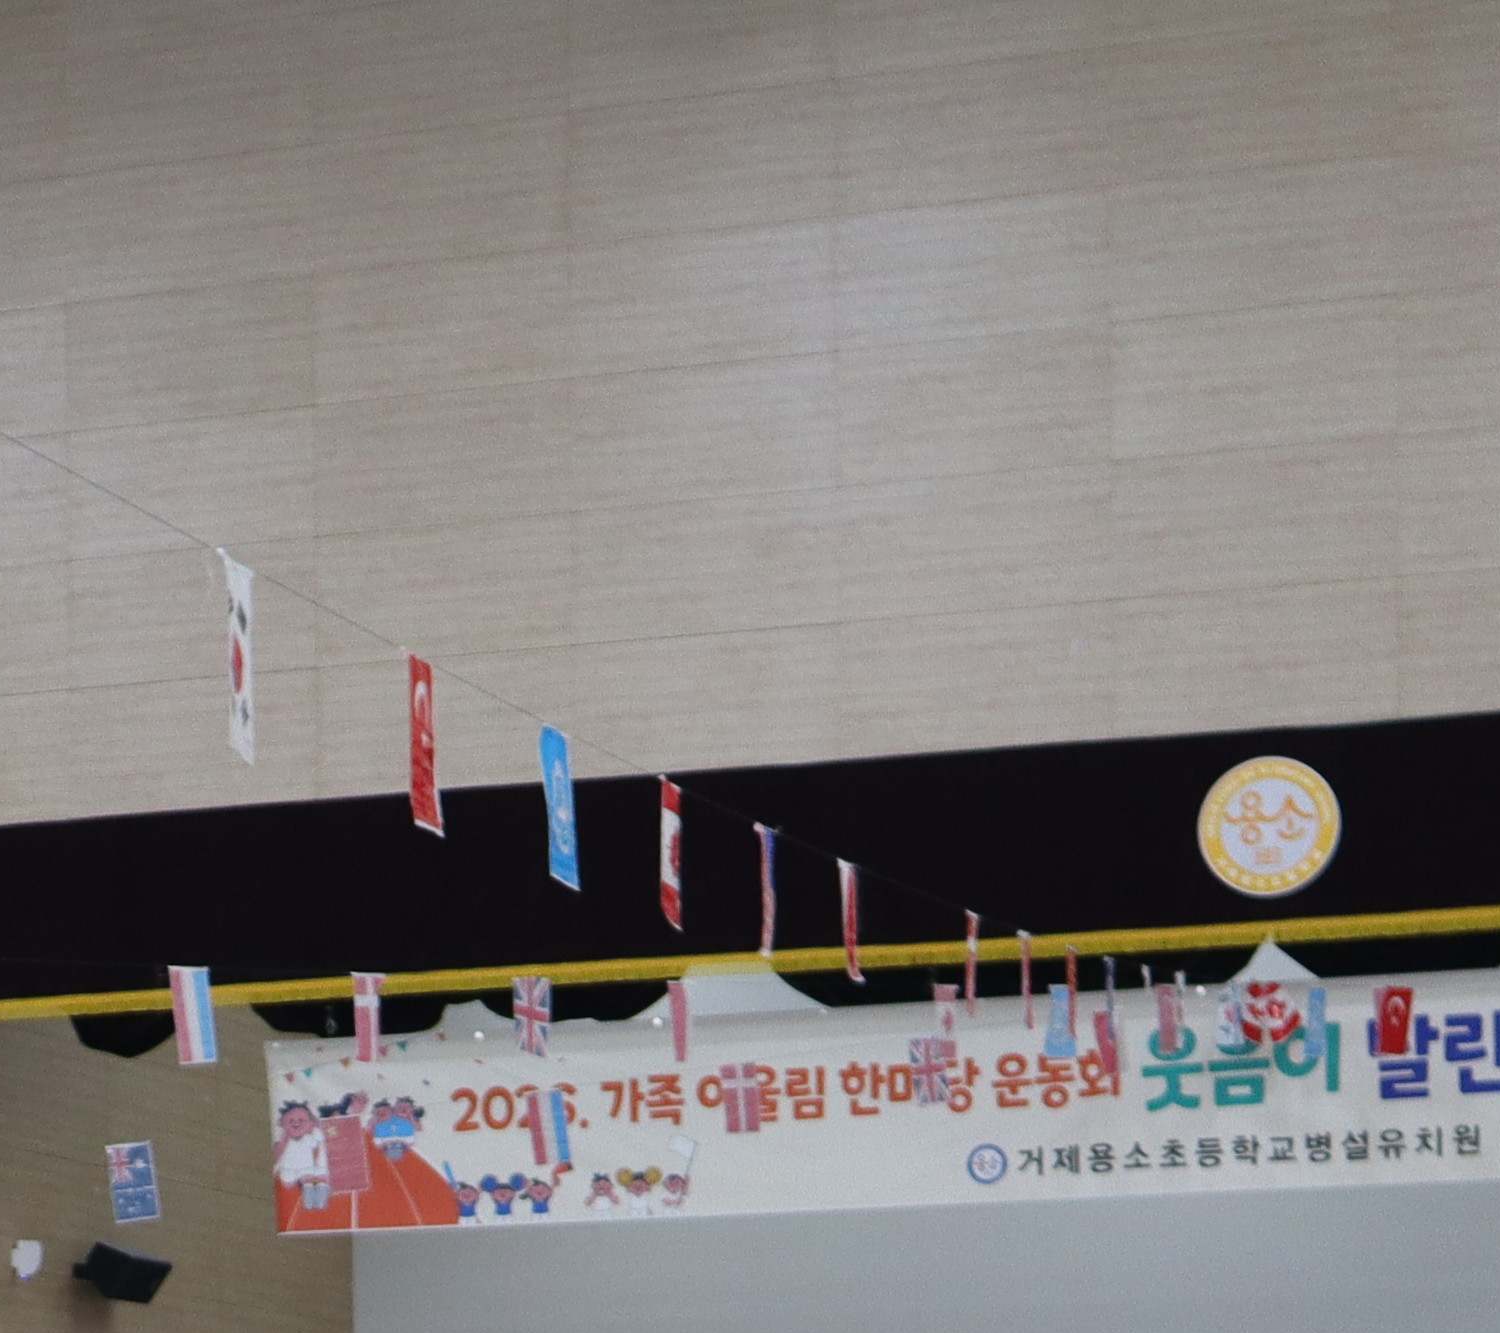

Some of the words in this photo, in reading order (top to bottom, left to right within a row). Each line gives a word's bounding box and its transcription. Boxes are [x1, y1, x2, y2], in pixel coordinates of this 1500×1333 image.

[601, 1072, 684, 1126] 가족
[991, 1048, 1121, 1110] 운동회
[1017, 1123, 1484, 1176] 거제용소초등학교병설유치원
